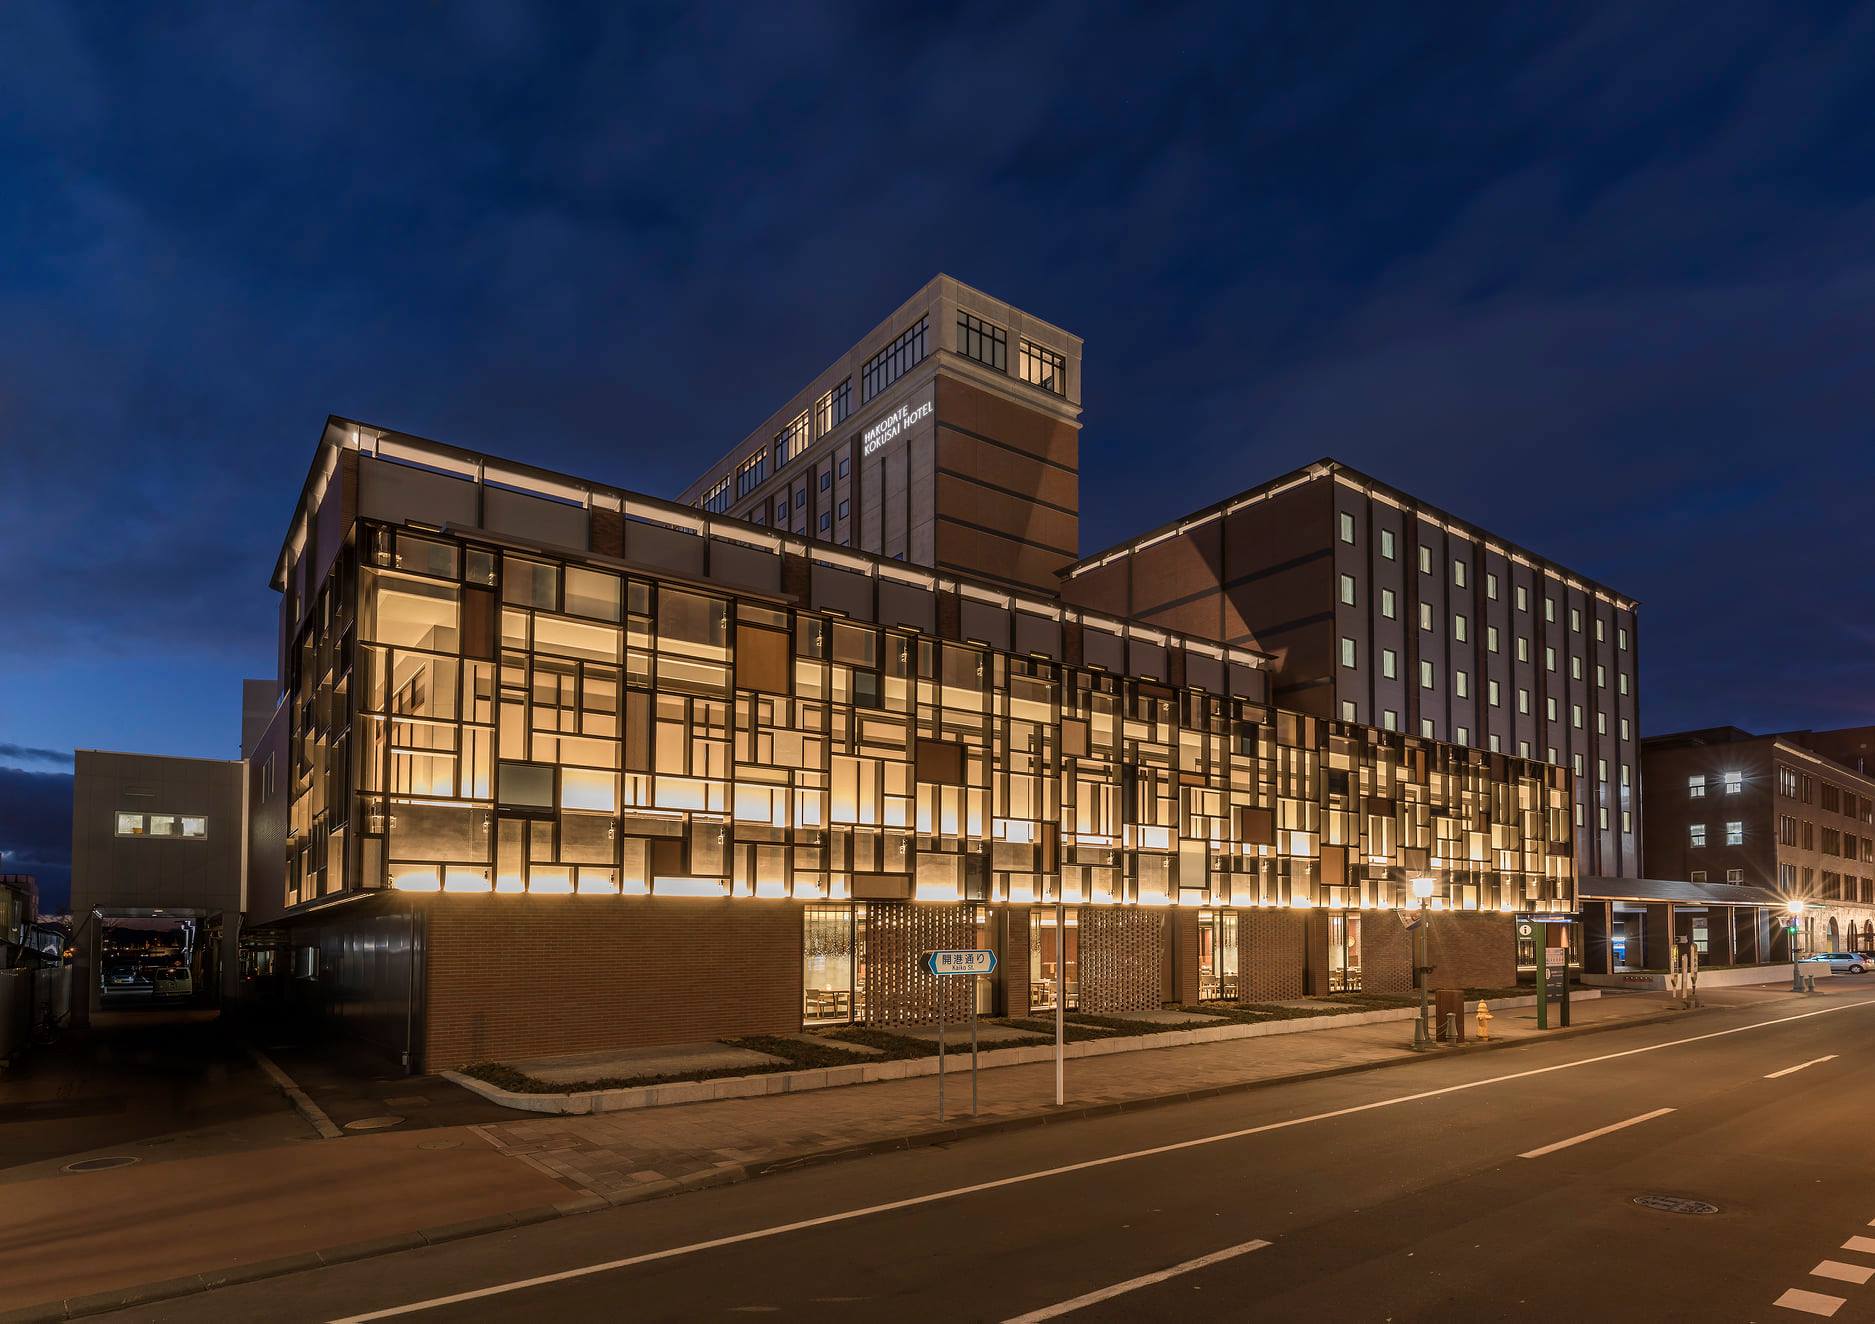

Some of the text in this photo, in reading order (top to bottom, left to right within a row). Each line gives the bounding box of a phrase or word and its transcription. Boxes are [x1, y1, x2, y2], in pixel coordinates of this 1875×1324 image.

[864, 405, 909, 443] HAKODATE
[864, 401, 934, 456] KOKUSAI HOTEL
[942, 953, 985, 965] 開港通り
